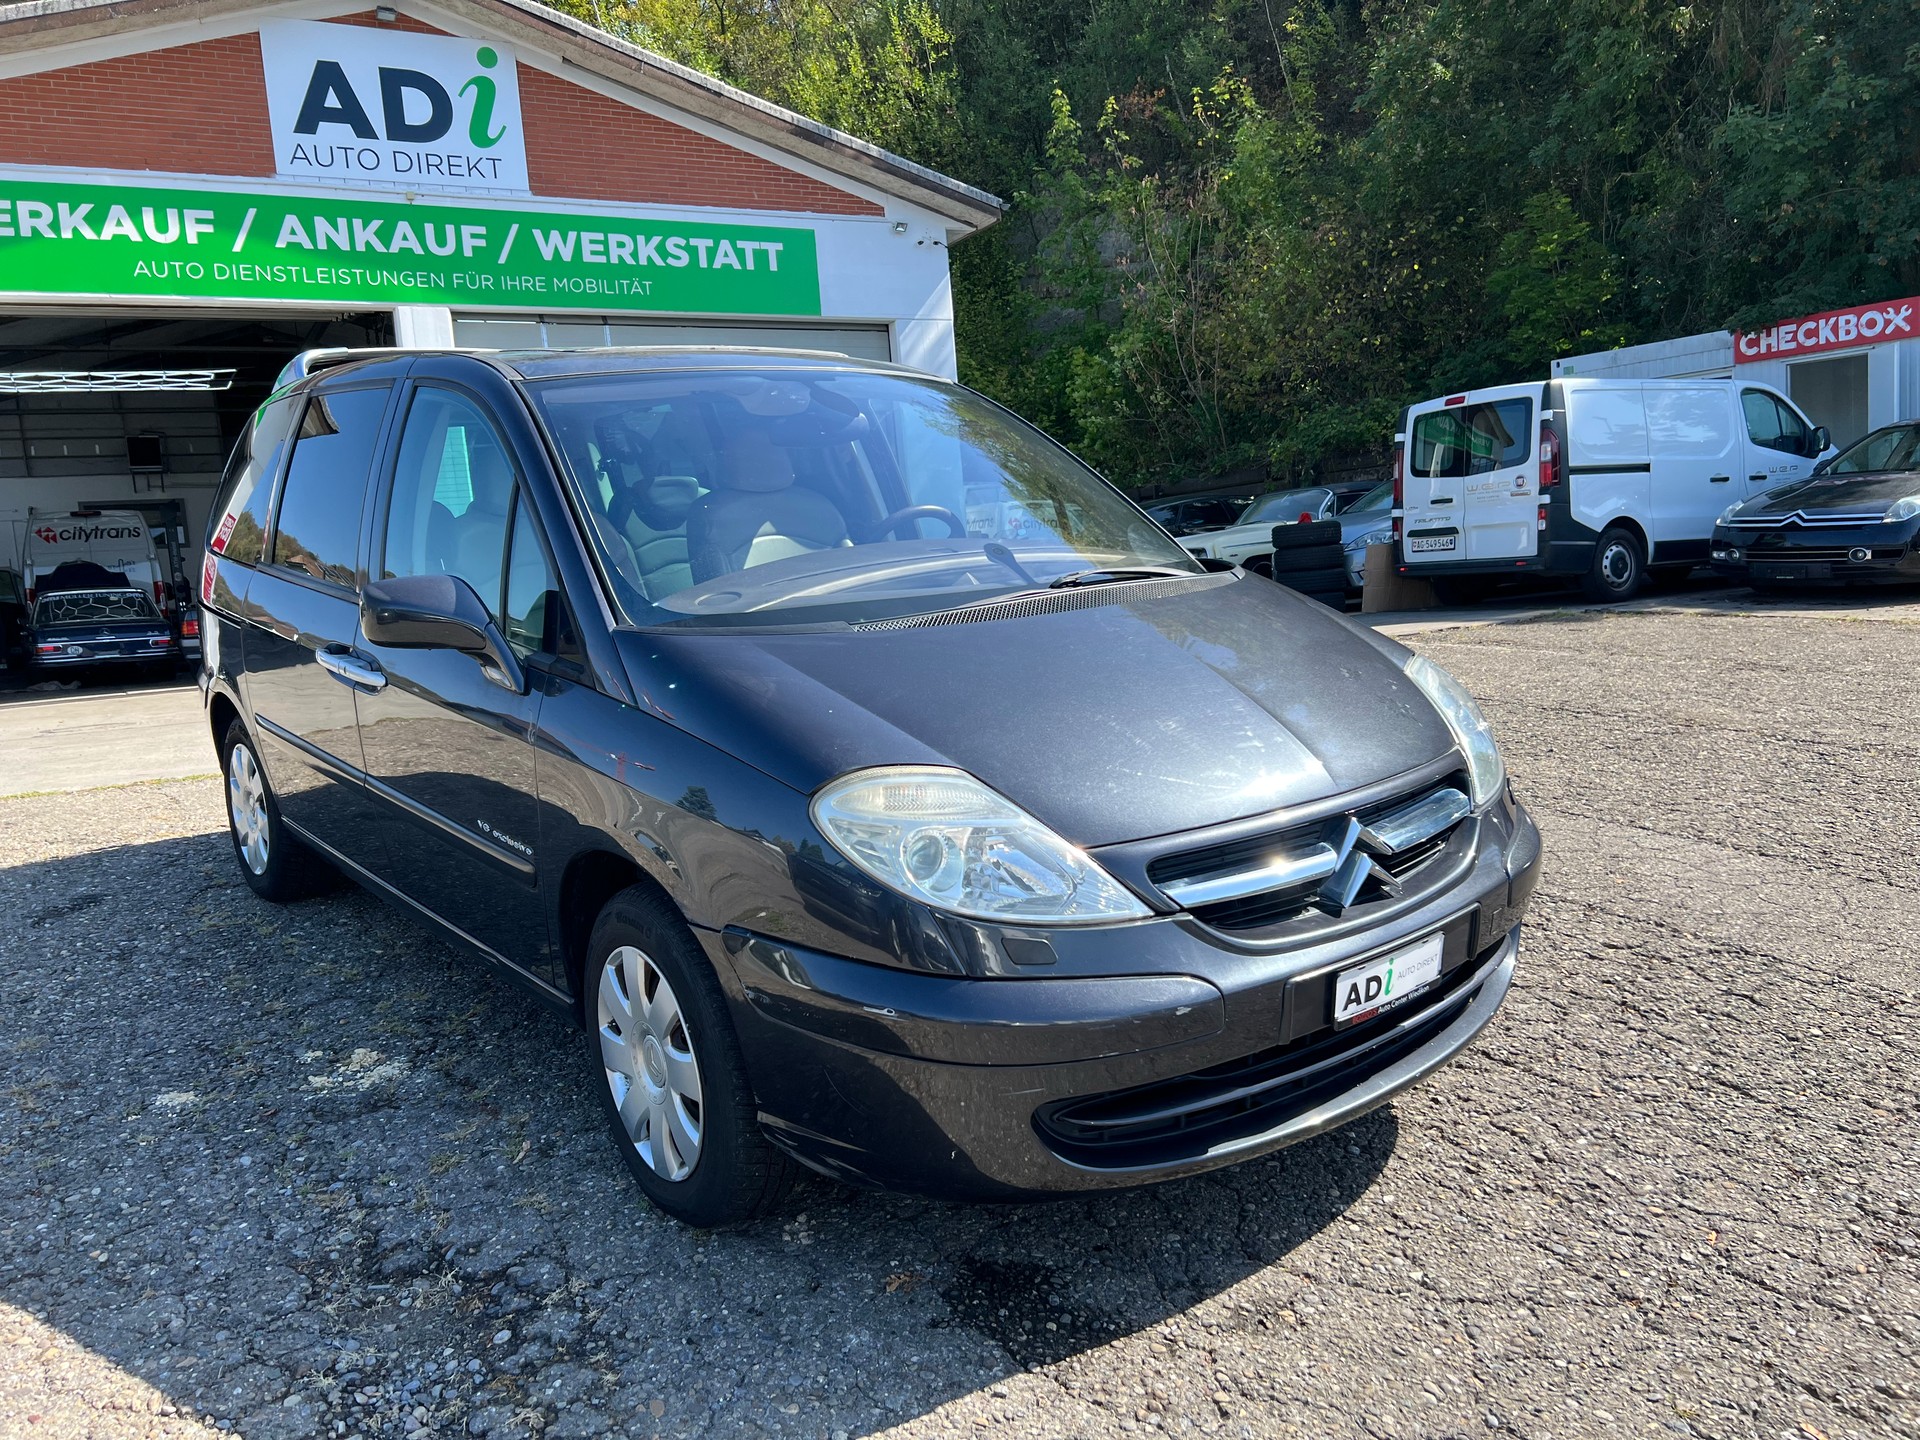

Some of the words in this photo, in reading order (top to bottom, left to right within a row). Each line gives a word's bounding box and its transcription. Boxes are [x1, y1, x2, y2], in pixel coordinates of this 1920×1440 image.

[289, 143, 380, 171] AUTO
[392, 151, 502, 179] DIREKT
[0, 199, 214, 245] ERKAUF
[275, 214, 487, 258] ANKAUF
[531, 228, 784, 272] WERKSTATT
[133, 260, 205, 280] AUTO
[214, 263, 446, 288] DIENSTLEISTUNGEN
[453, 271, 494, 290] FÜR
[500, 275, 547, 292] IHRE
[553, 277, 653, 296] MOBILITÄT
[1739, 304, 1912, 356] CHECKBOX
[59, 525, 141, 543] citytrans
[1023, 517, 1058, 532] citytra
[1396, 965, 1416, 980] AUTO
[1416, 953, 1439, 972] DIREKT
[1377, 1004, 1391, 1014] Auto
[1391, 995, 1408, 1008] Center
